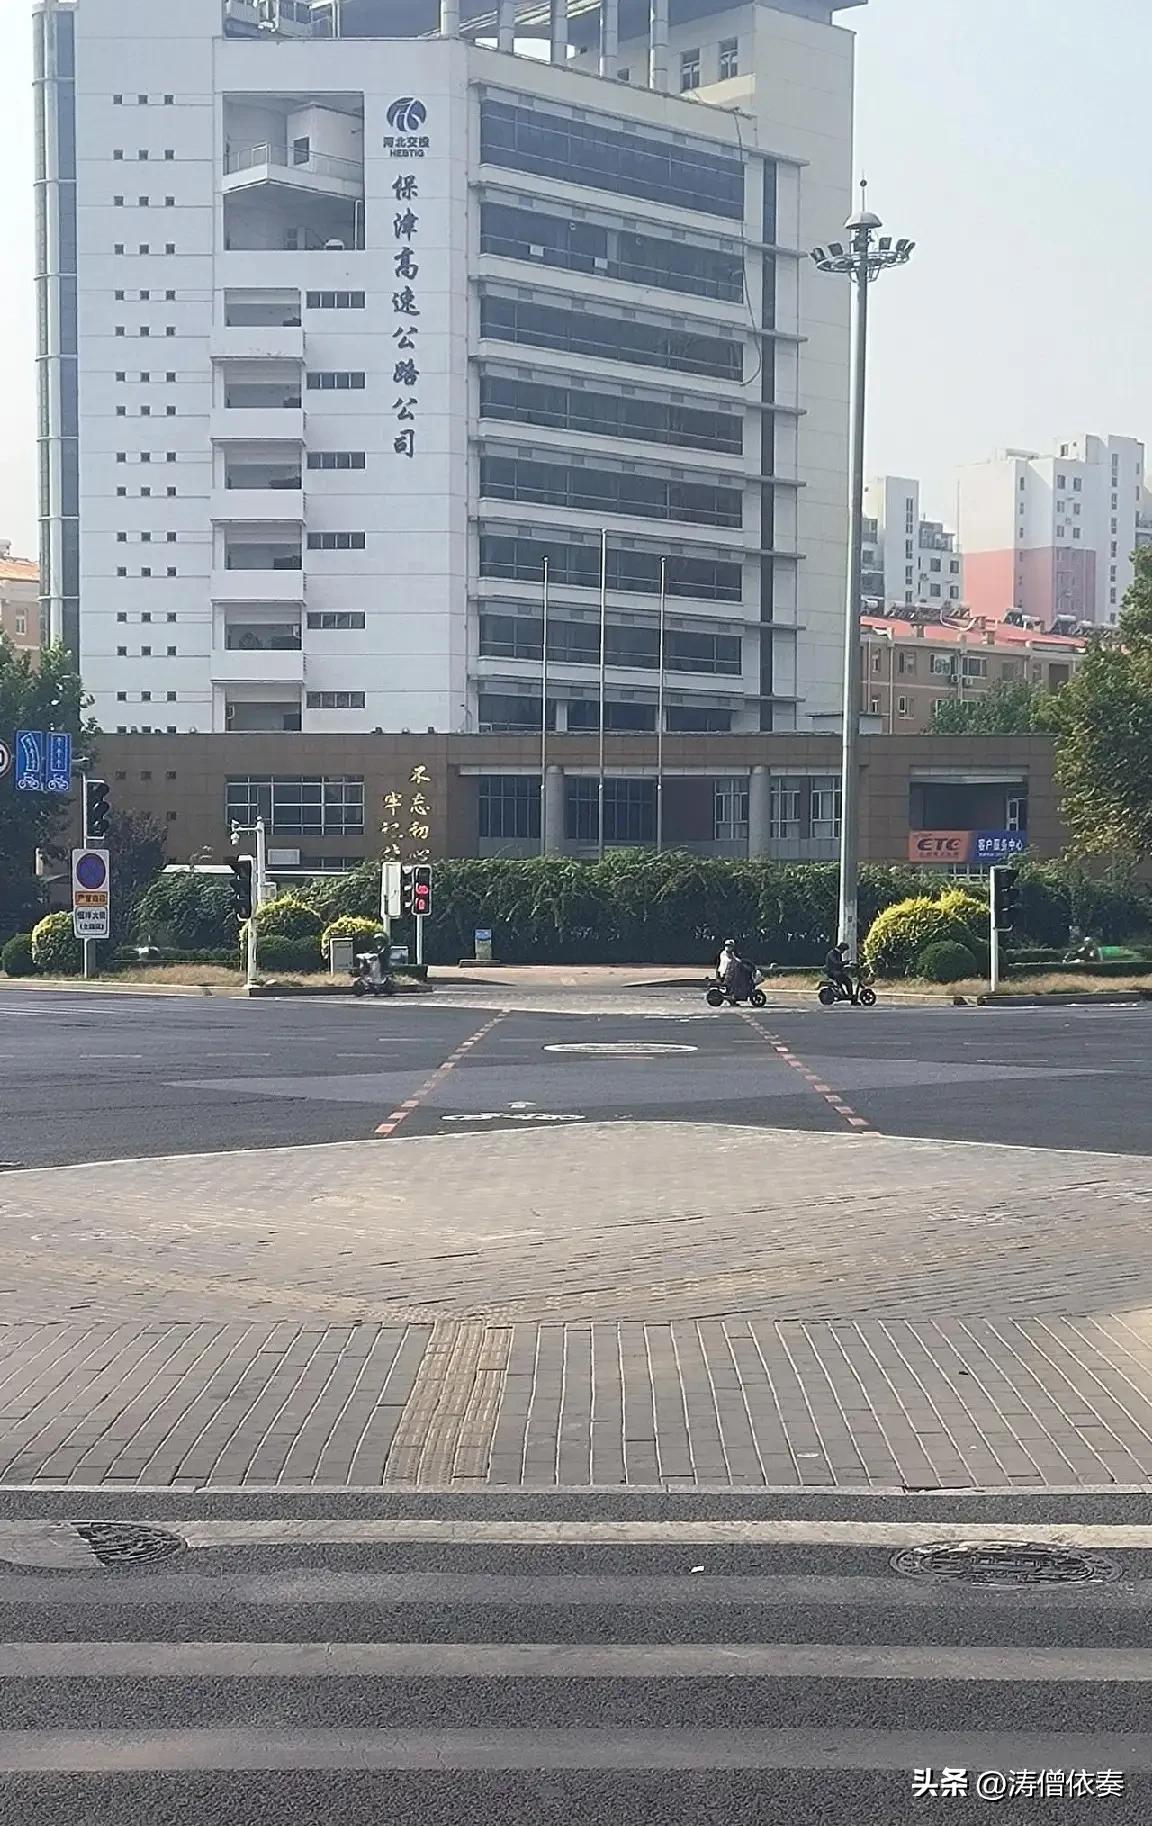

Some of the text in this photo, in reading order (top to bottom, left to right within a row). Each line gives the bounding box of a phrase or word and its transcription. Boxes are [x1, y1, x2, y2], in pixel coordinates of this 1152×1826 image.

[392, 174, 420, 459] 保津高速公路公司
[409, 765, 432, 862] 不忘初心
[917, 838, 961, 851] ETC
